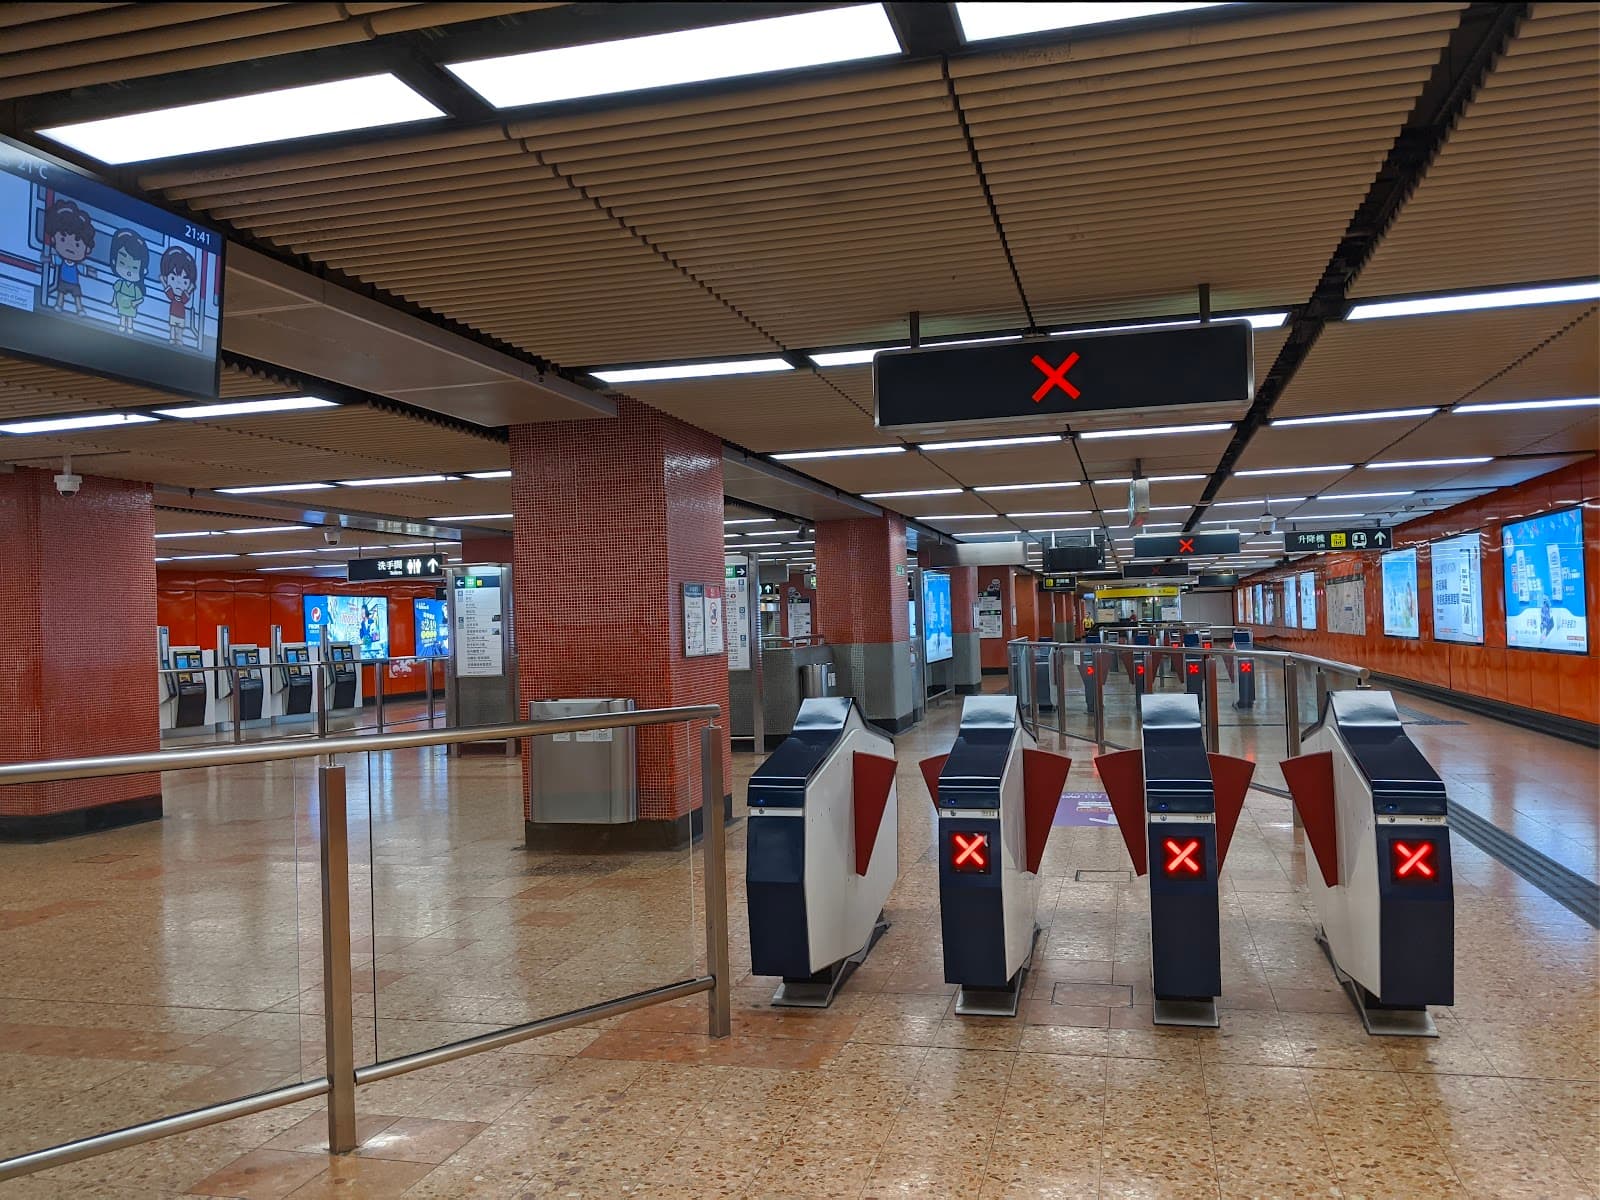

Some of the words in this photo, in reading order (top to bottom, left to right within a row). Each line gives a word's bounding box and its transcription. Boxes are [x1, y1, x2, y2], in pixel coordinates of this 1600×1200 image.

[184, 224, 210, 246] 21:41
[1298, 533, 1326, 544] 升降機
[376, 559, 403, 571] 洗手間
